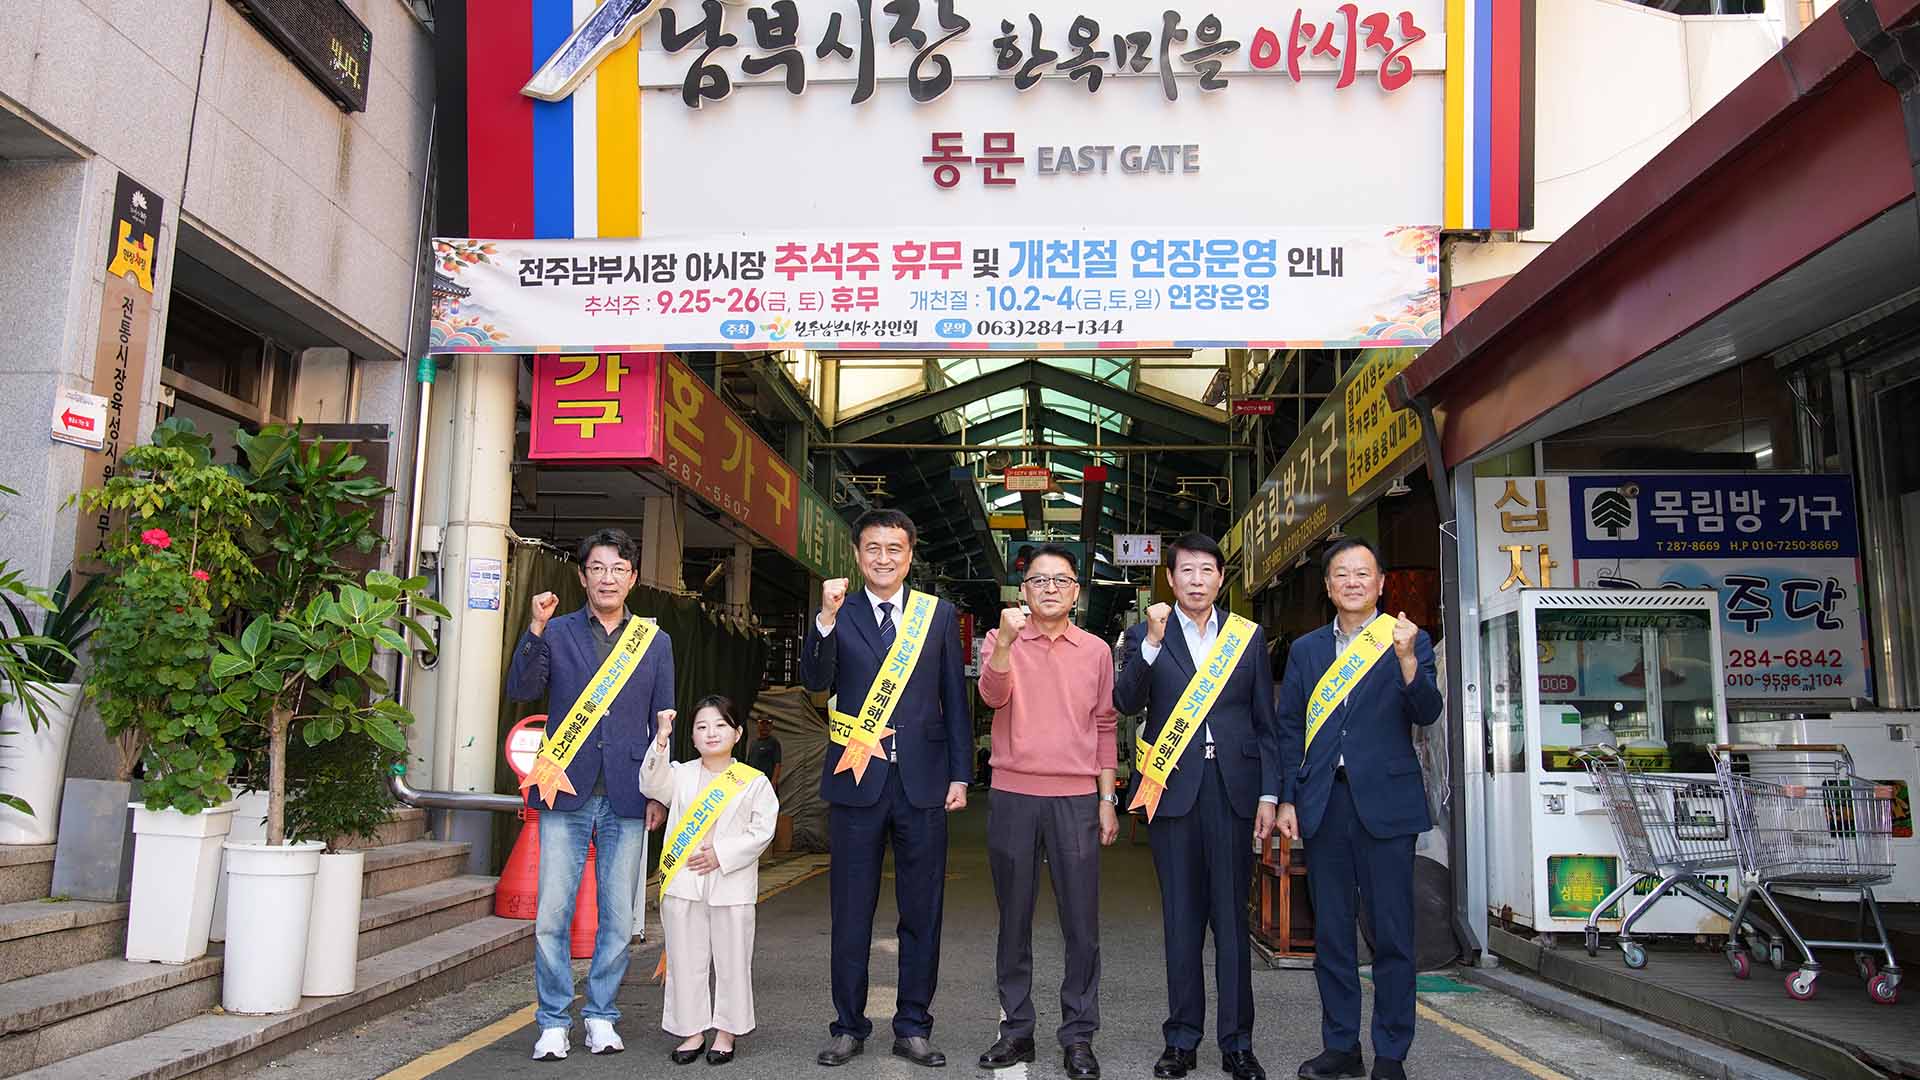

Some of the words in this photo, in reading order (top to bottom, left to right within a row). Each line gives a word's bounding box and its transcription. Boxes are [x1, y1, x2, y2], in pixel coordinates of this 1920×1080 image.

[658, 0, 973, 109] 남부시장
[993, 9, 1242, 103] 한옥마을
[1248, 3, 1430, 93] 야시장
[922, 131, 1024, 192] 동문
[1037, 145, 1115, 176] EAST
[1119, 143, 1201, 176] GATE
[519, 253, 677, 288] 전주남부시장
[686, 251, 767, 282] 야시장
[774, 241, 881, 282] 추석주
[891, 240, 963, 281] 휴무
[972, 247, 1000, 279] 및
[1008, 239, 1118, 280] 개천절
[1130, 239, 1277, 279] 연장운영
[1287, 247, 1344, 278] 안내
[584, 296, 641, 318] 추석주
[830, 286, 880, 313] 휴무
[909, 289, 968, 311] 개천절
[1167, 284, 1270, 311] 연장운영
[976, 320, 1124, 338] 063)284-1344
[553, 355, 629, 439] 가구
[667, 453, 752, 521] 287-5507
[1650, 489, 1765, 534] 목림방
[1778, 495, 1842, 532] 가구
[1656, 542, 1664, 552] T
[1666, 541, 1721, 552] 287-8669
[1752, 540, 1840, 552] 010-7250-8669
[1208, 631, 1242, 680] 전통시장
[1320, 652, 1366, 703] 전통시장
[859, 678, 897, 735] 함께해요
[1152, 717, 1190, 773] 함께해요
